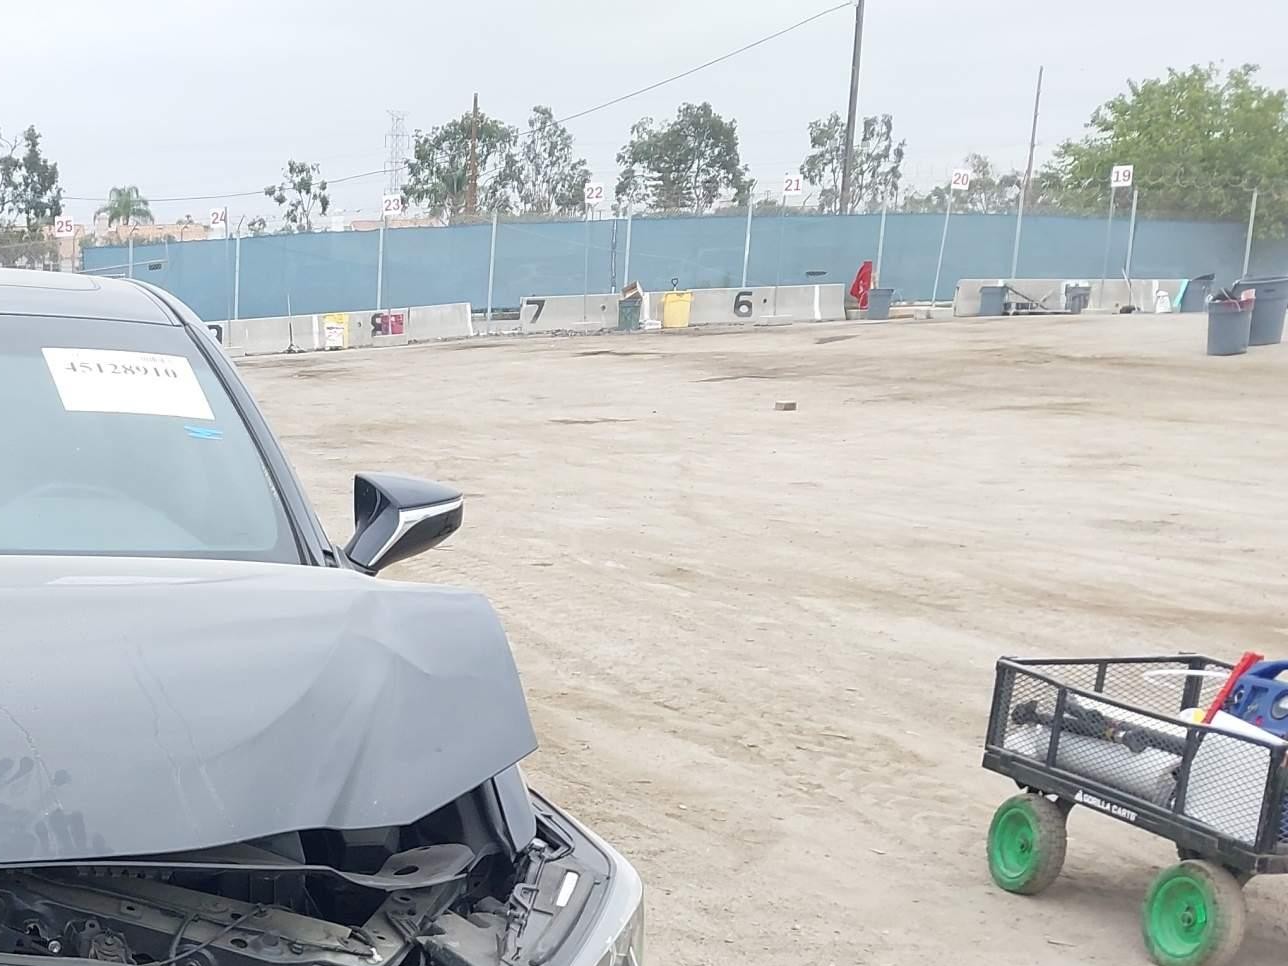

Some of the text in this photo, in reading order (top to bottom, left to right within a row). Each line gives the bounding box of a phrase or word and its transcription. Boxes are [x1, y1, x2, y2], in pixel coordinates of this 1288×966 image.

[952, 172, 969, 185] 20
[1112, 169, 1131, 182] 19
[784, 178, 801, 191] 21
[586, 186, 603, 199] 22
[384, 198, 400, 211] 23
[211, 210, 227, 224] 24
[56, 219, 73, 232] 25
[733, 291, 753, 318] 6
[526, 299, 546, 324] 7
[65, 361, 178, 379] 45128910
